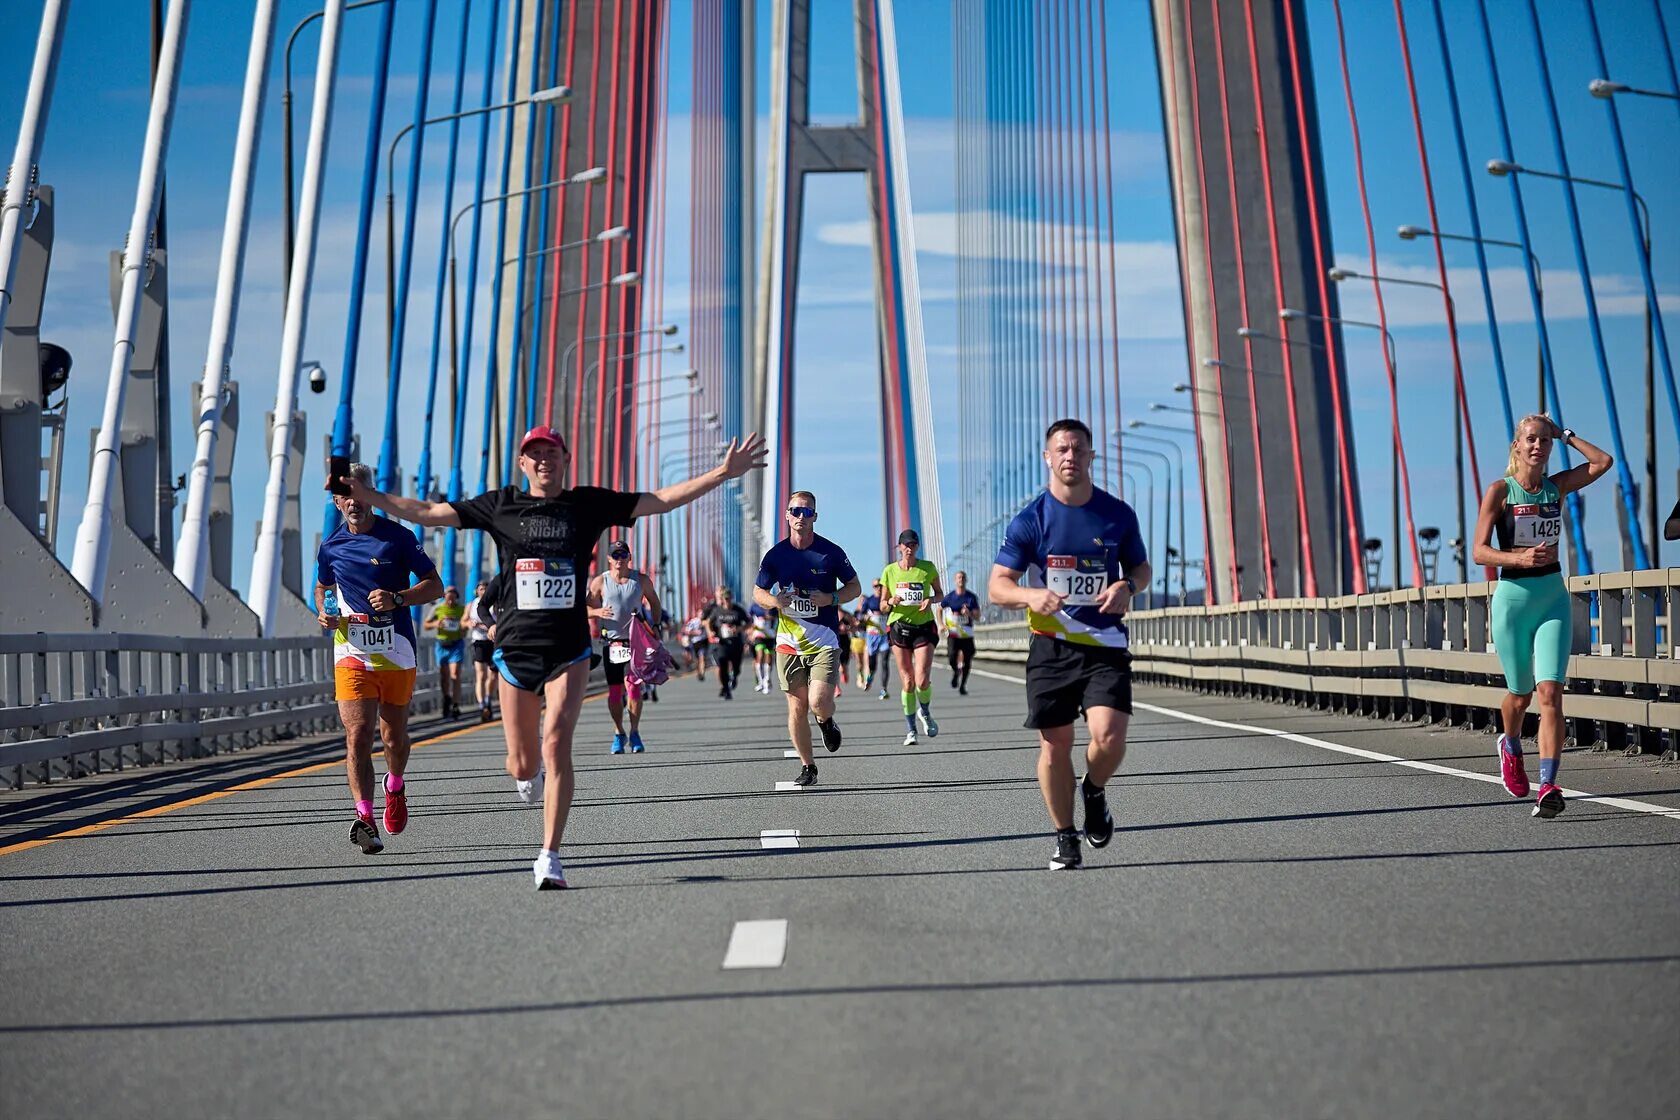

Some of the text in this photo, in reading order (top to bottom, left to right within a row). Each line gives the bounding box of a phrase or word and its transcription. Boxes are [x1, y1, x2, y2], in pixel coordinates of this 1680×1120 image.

[529, 526, 568, 538] NIGHT
[1531, 520, 1560, 538] 1425
[520, 562, 534, 570] 21.1
[1051, 559, 1066, 567] 21.1
[535, 579, 573, 598] 1222
[1066, 576, 1105, 595] 1287
[904, 591, 923, 601] 1530
[361, 629, 392, 646] 1041
